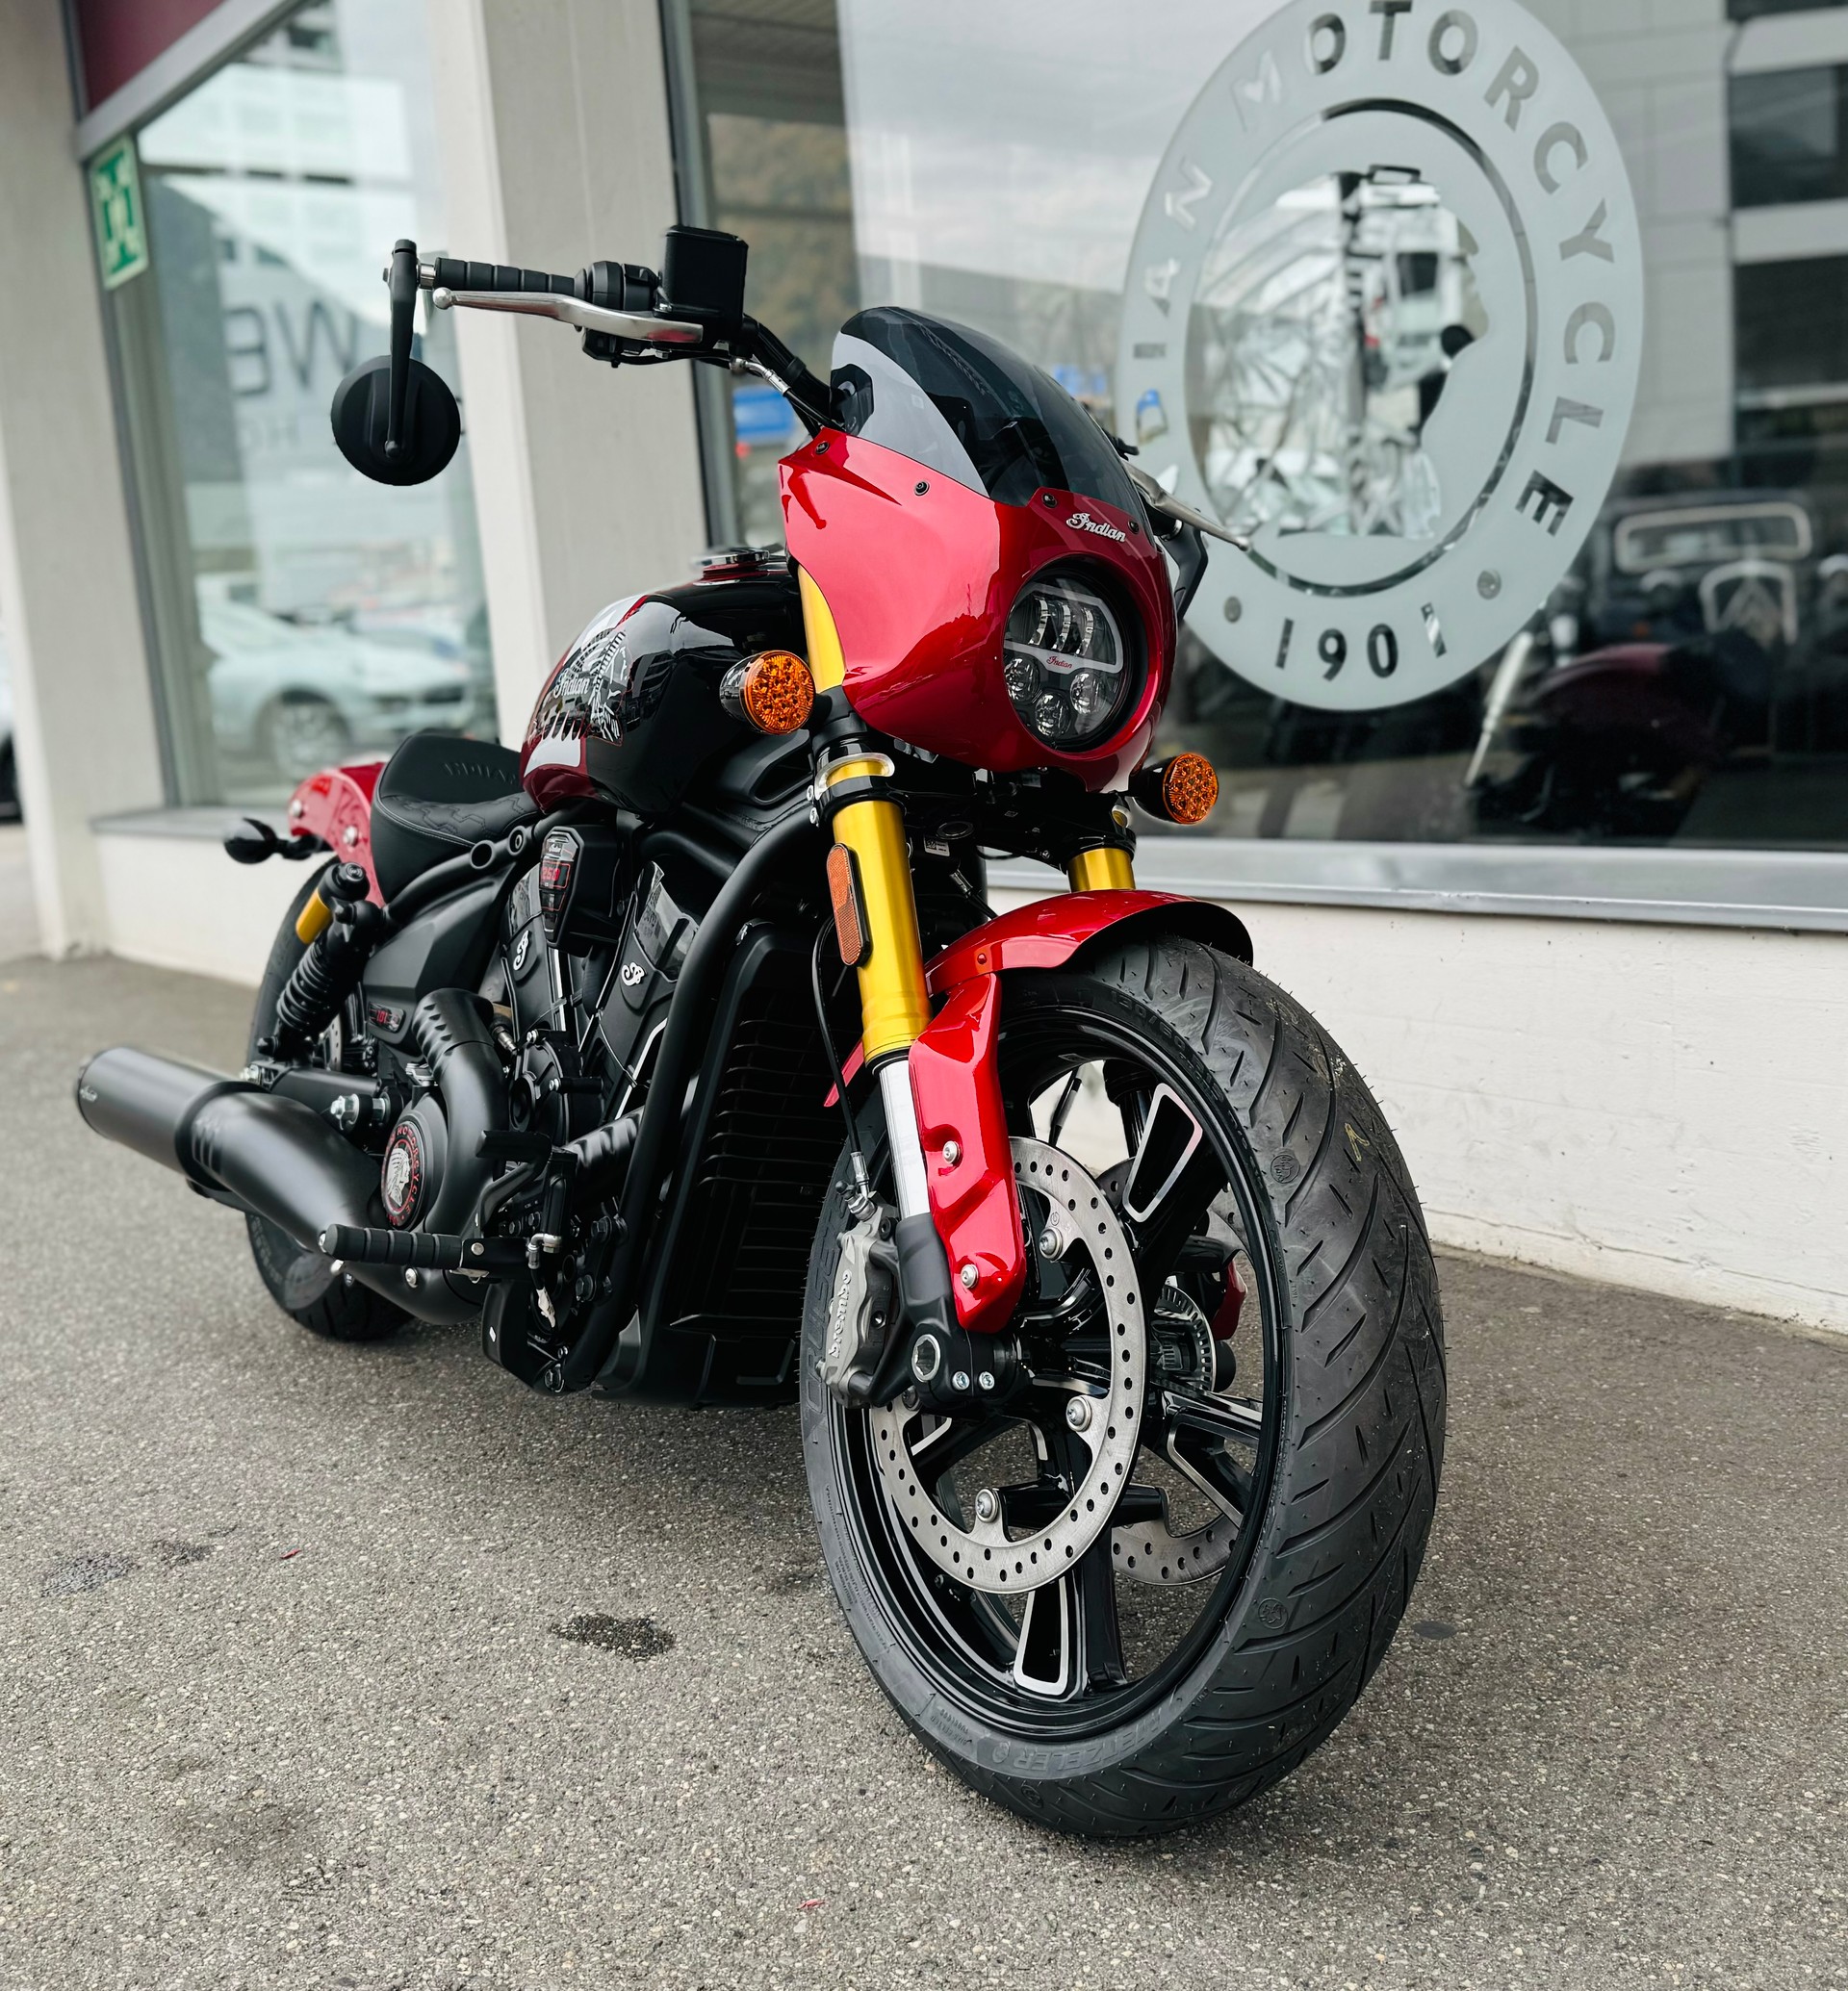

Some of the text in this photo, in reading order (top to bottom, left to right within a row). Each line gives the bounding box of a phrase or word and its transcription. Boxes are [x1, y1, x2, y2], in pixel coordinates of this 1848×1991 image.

[1231, 0, 1616, 536] MOTORCYCLE
[1066, 512, 1126, 542] Indian
[1046, 655, 1073, 670] Indian
[1275, 601, 1448, 680] 1901
[553, 668, 589, 699] Indian
[828, 1269, 852, 1360] brembo
